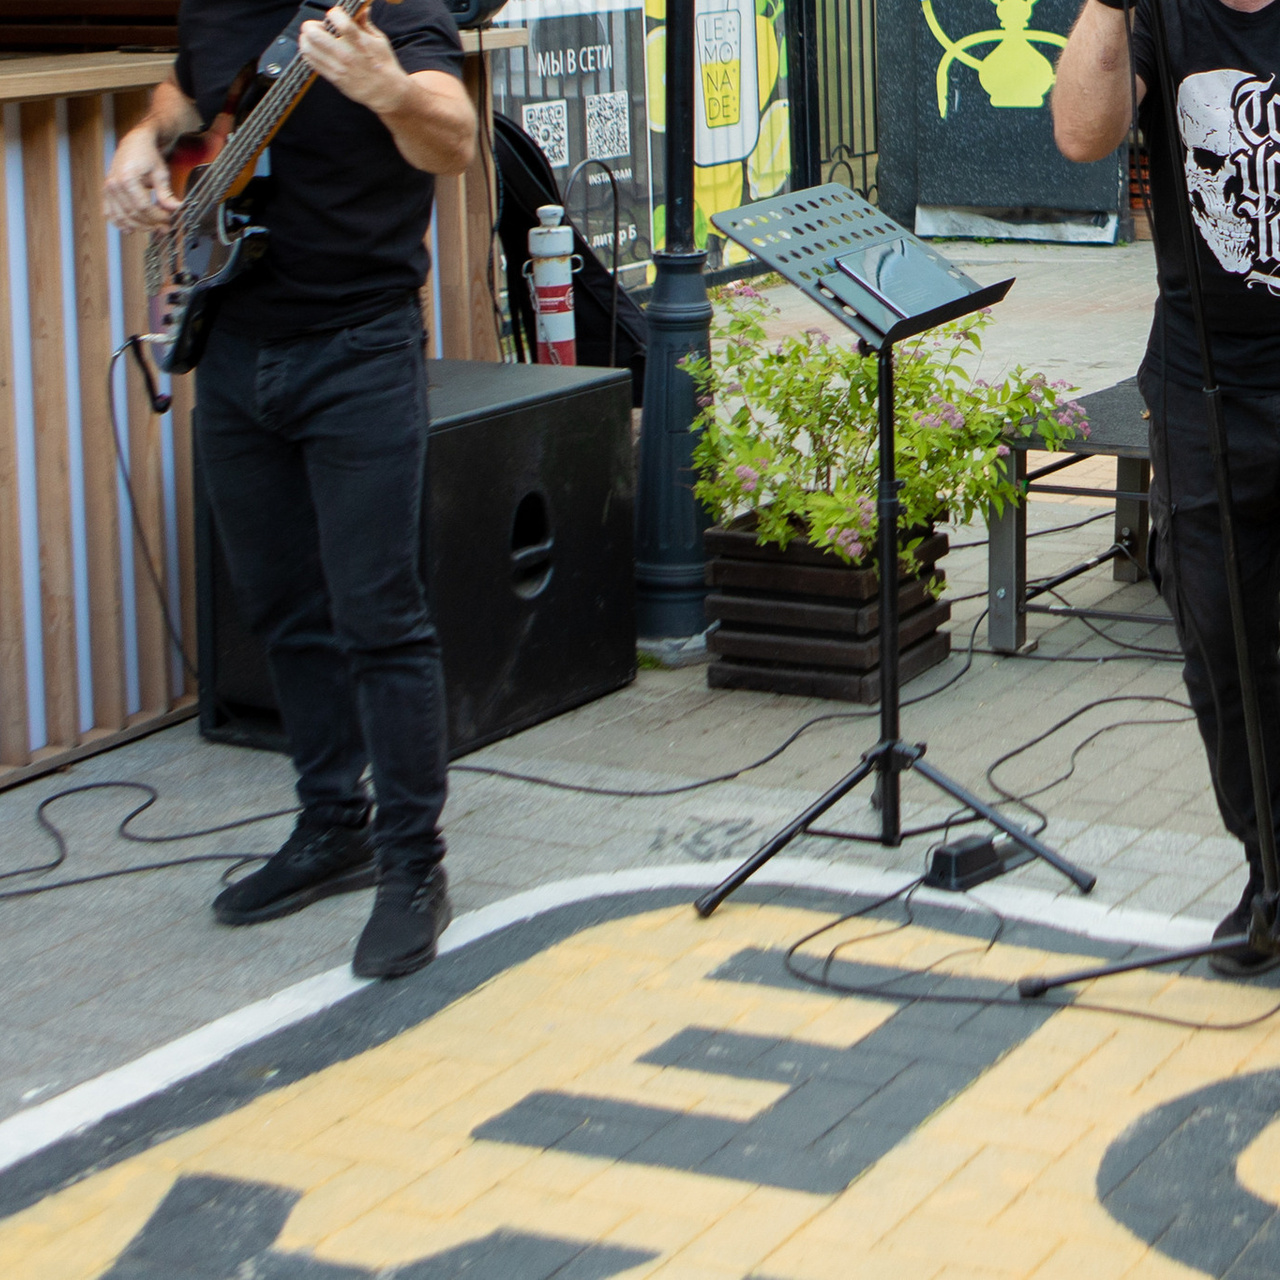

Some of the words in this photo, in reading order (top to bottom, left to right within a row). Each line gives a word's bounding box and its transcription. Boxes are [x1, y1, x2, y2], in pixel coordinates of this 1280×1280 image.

[703, 17, 724, 42] LE
[537, 50, 564, 79] МЫ
[567, 48, 577, 75] В
[578, 43, 613, 72] СЕТИ
[704, 41, 734, 67] MO
[706, 68, 733, 94] NA
[708, 94, 731, 121] DE
